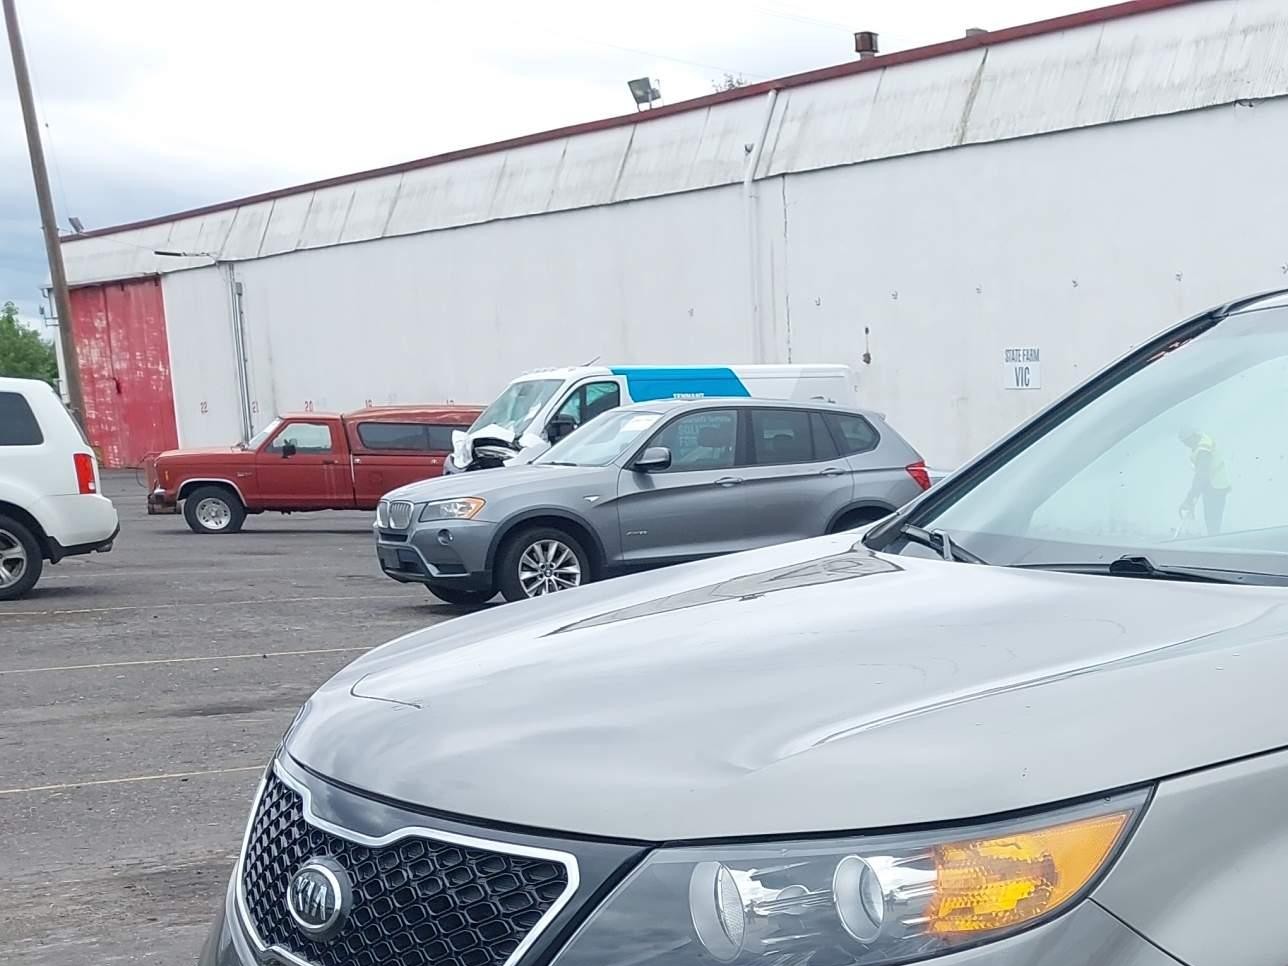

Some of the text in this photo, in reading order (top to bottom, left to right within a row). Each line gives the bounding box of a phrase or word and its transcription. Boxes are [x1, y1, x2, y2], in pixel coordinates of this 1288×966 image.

[1005, 348, 1040, 362] STATE FARM
[1015, 366, 1030, 387] VIC
